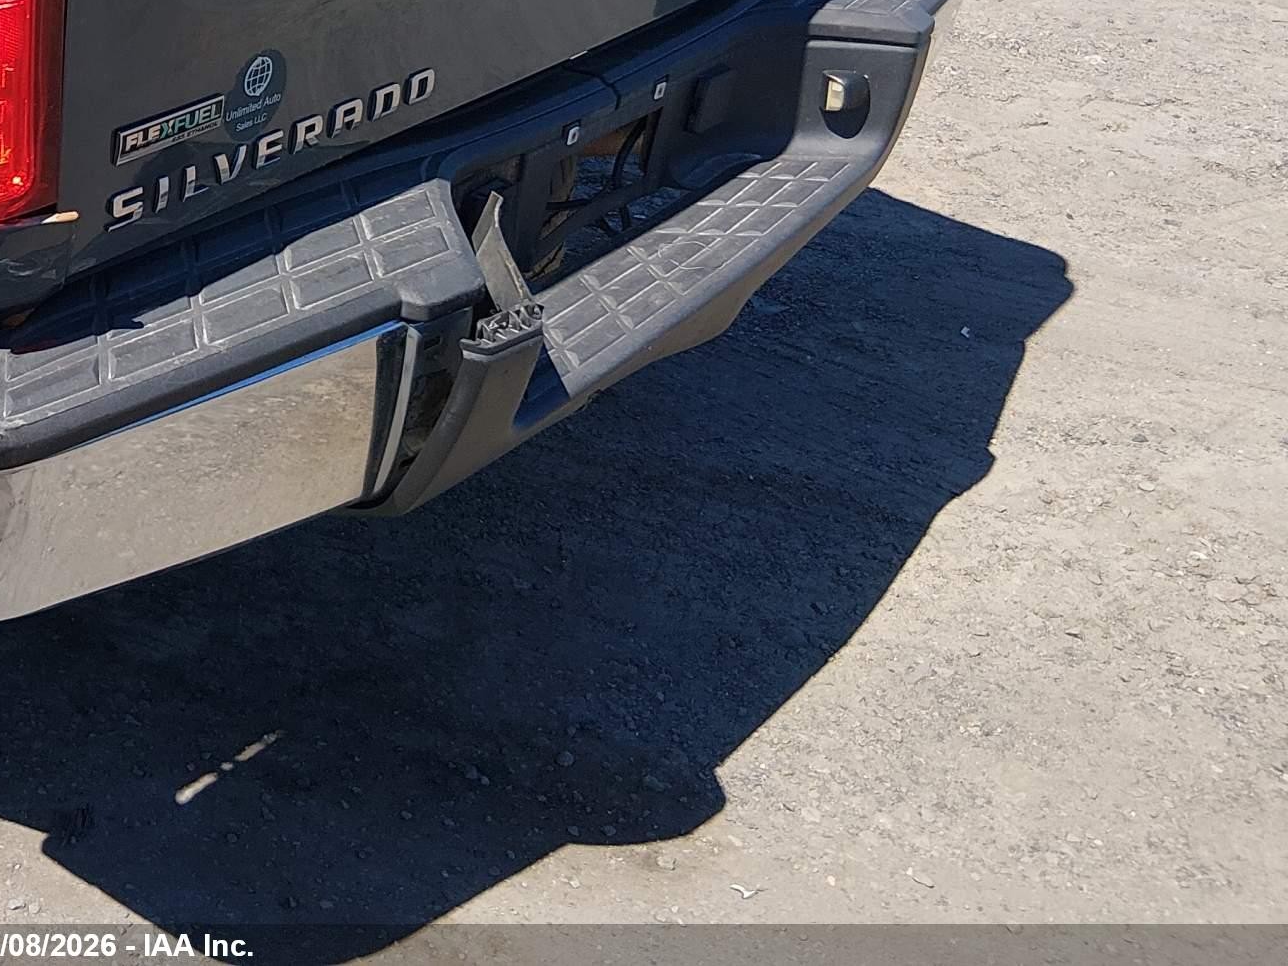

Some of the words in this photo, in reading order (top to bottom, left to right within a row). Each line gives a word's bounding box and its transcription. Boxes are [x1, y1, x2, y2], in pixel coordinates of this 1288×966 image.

[124, 102, 221, 152] FLEXFUEL
[225, 98, 264, 122] Unlimited
[263, 93, 282, 107] Auto
[236, 119, 254, 133] Sales
[253, 112, 268, 126] LLC
[105, 67, 436, 233] SILVERADO
